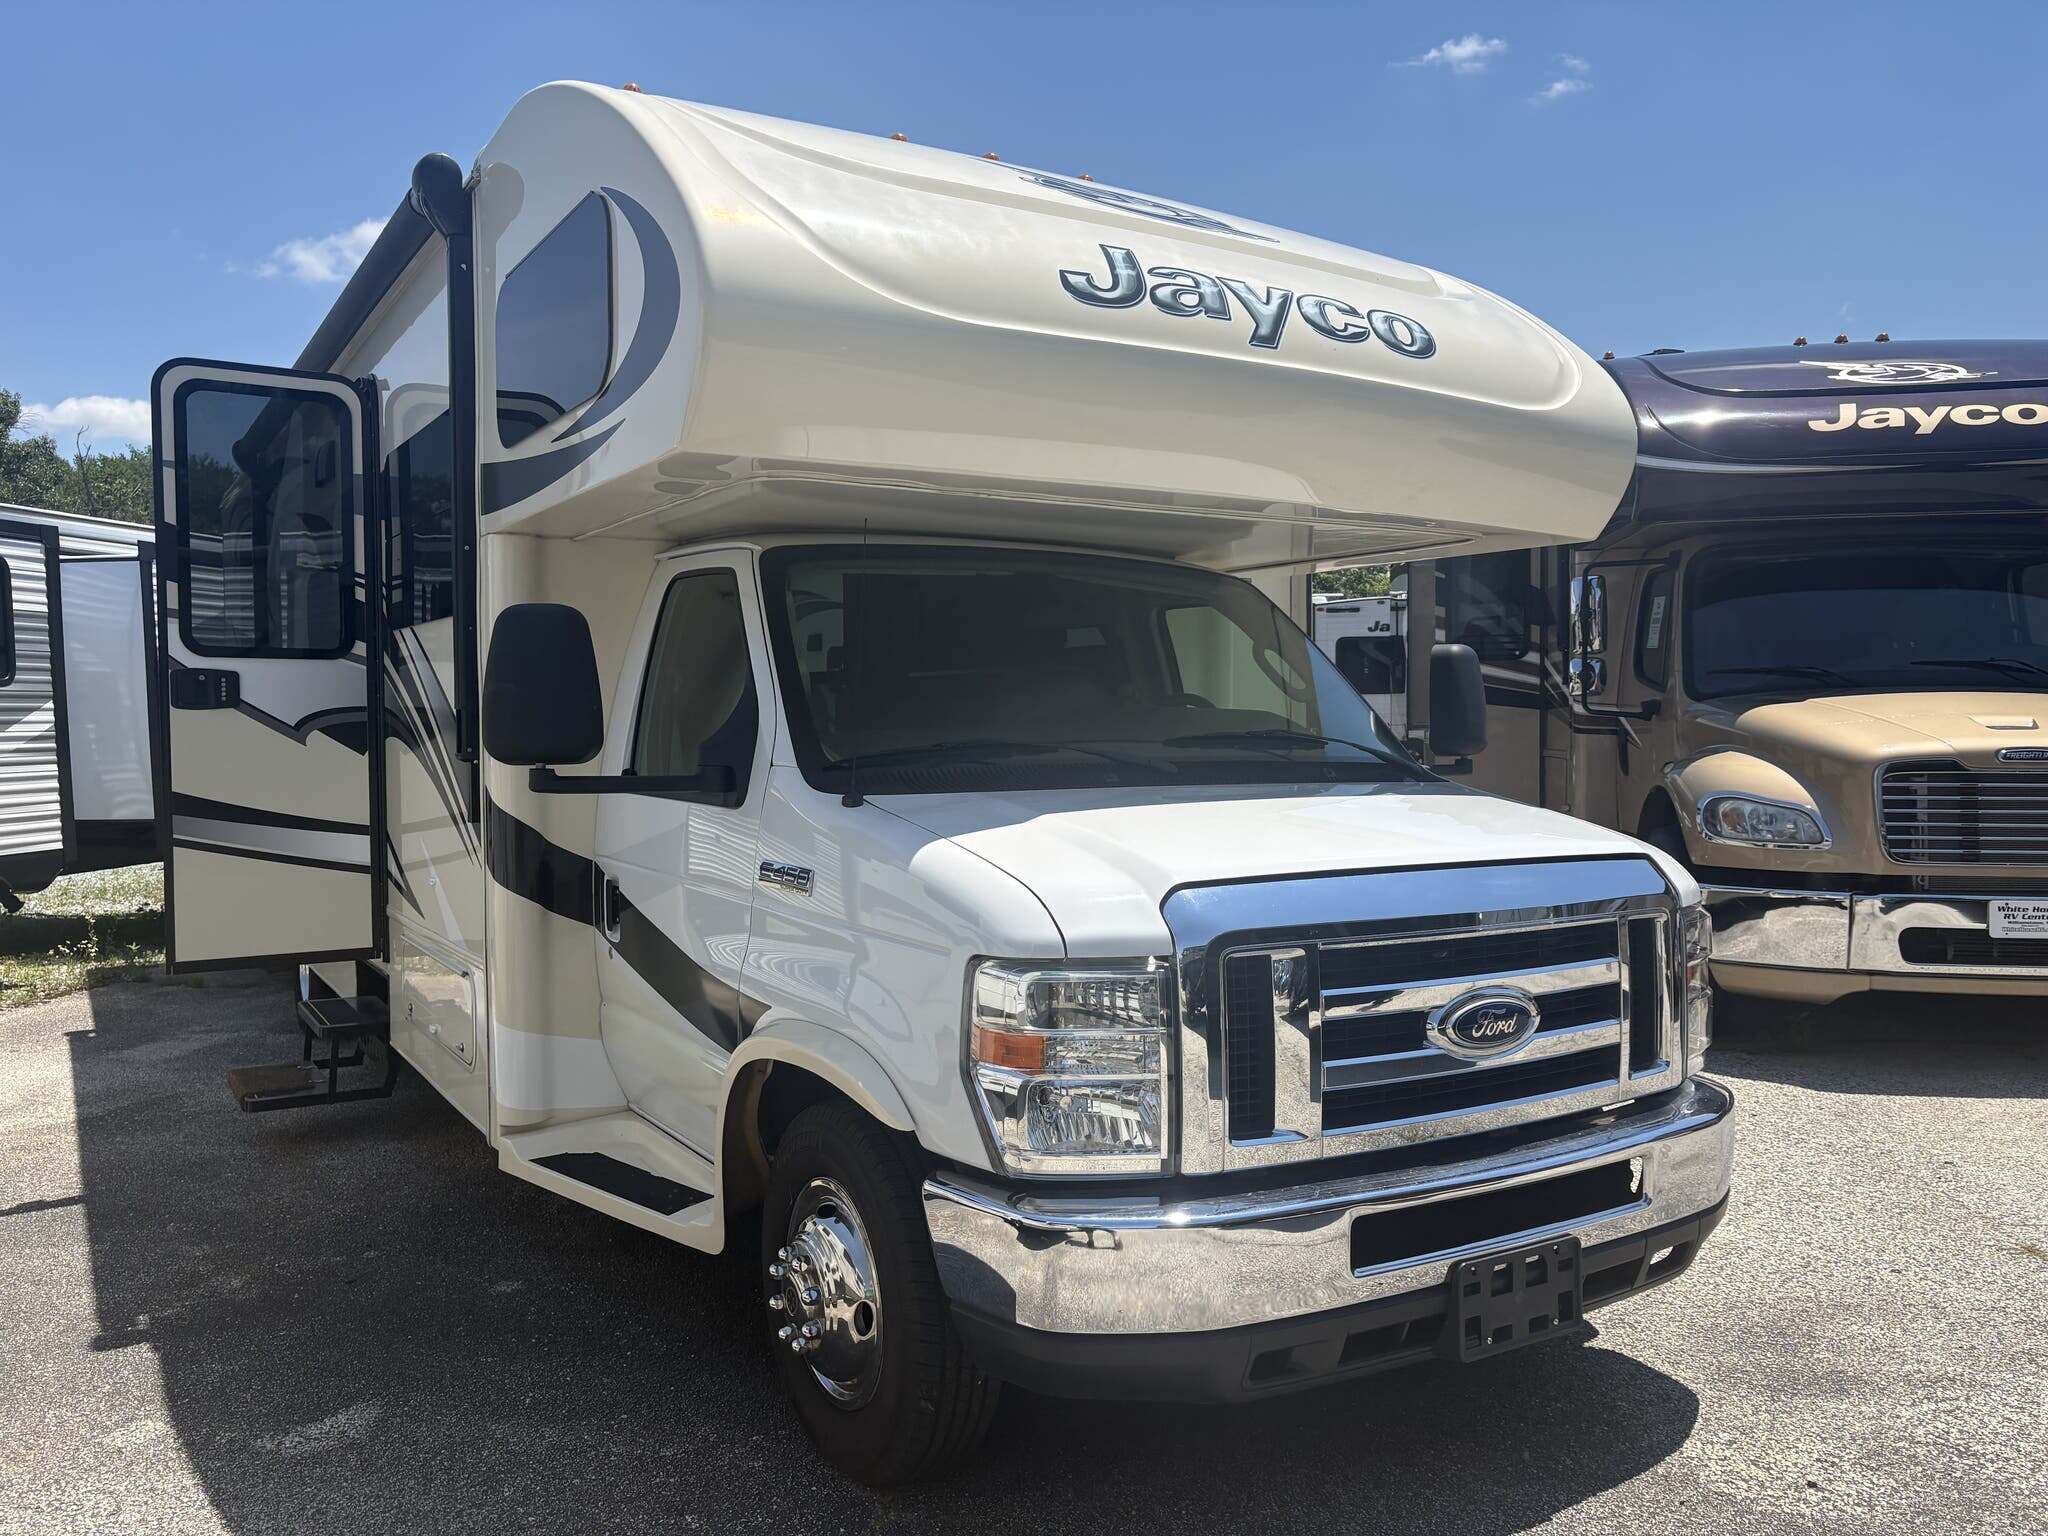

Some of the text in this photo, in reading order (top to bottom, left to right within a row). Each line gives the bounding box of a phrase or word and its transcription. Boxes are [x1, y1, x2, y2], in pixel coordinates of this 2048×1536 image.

[1058, 243, 1438, 359] Jayco
[1808, 402, 2048, 435] Jayco
[1997, 904, 2029, 912] White
[1472, 1008, 1518, 1038] Ford
